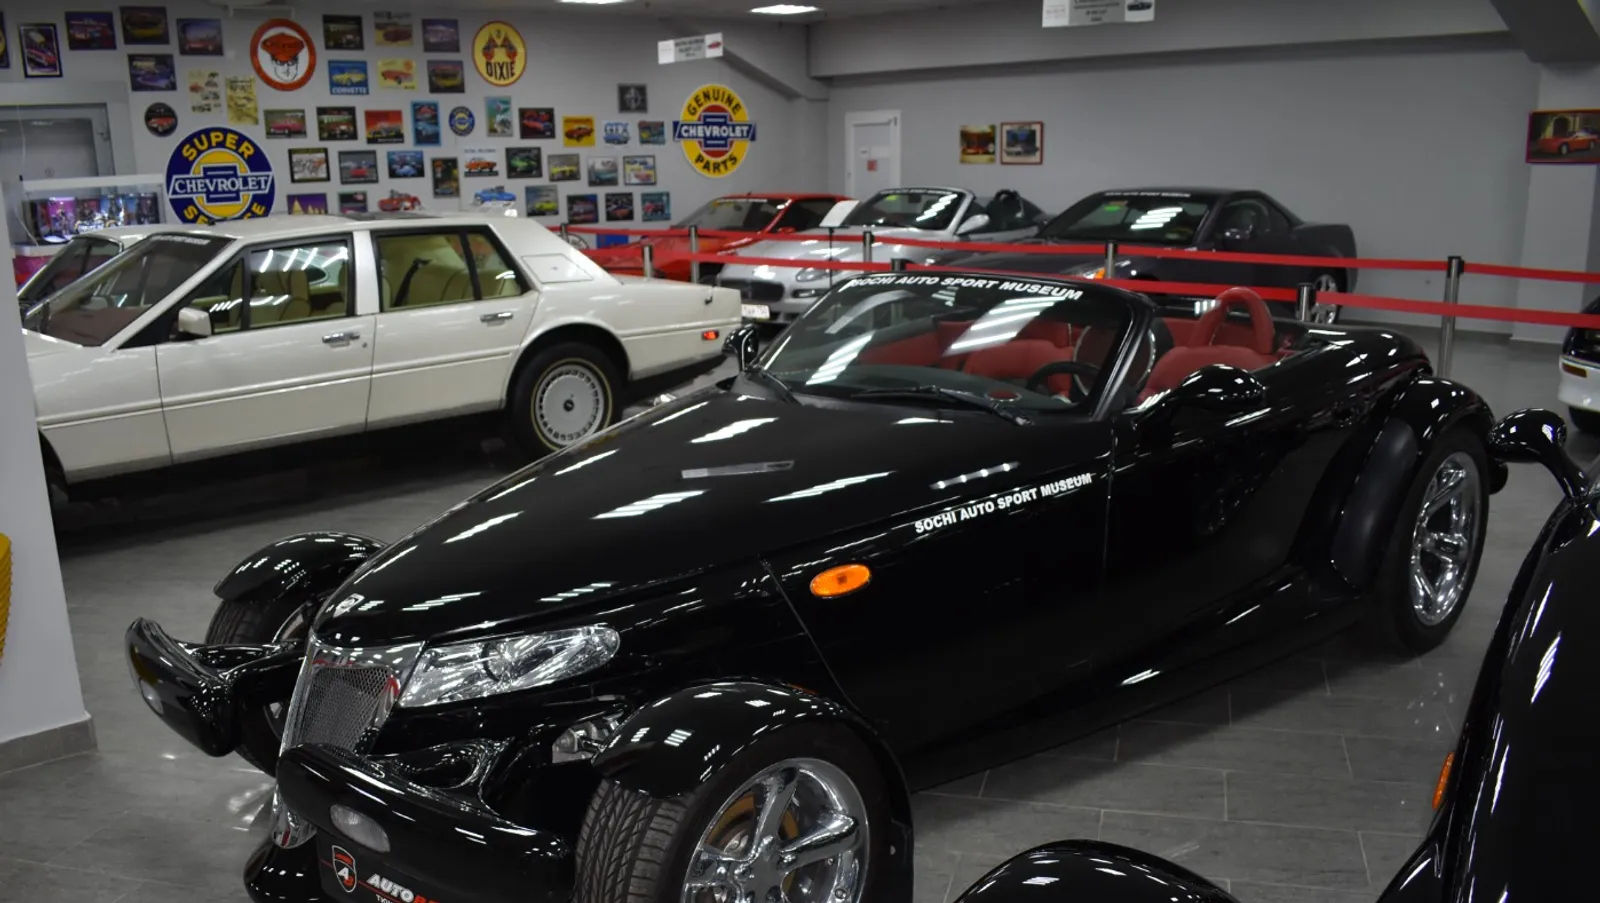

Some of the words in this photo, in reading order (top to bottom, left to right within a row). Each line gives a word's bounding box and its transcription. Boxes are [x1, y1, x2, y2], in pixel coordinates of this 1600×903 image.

[486, 61, 516, 80] DIXIE
[331, 86, 368, 94] CORVETTE
[687, 89, 742, 116] GENUINE
[681, 125, 749, 137] CHEVROLET
[182, 131, 255, 161] SUPER
[695, 153, 738, 174] PARTS
[174, 176, 269, 193] CHEVROLET
[898, 276, 938, 286] AUTO
[940, 277, 998, 289] SPORT
[999, 280, 1084, 300] MUSEUM
[914, 512, 957, 534] SOCHI
[959, 501, 996, 521] AUTO
[996, 488, 1038, 510] SPORT
[1040, 472, 1093, 498] MUSEUM
